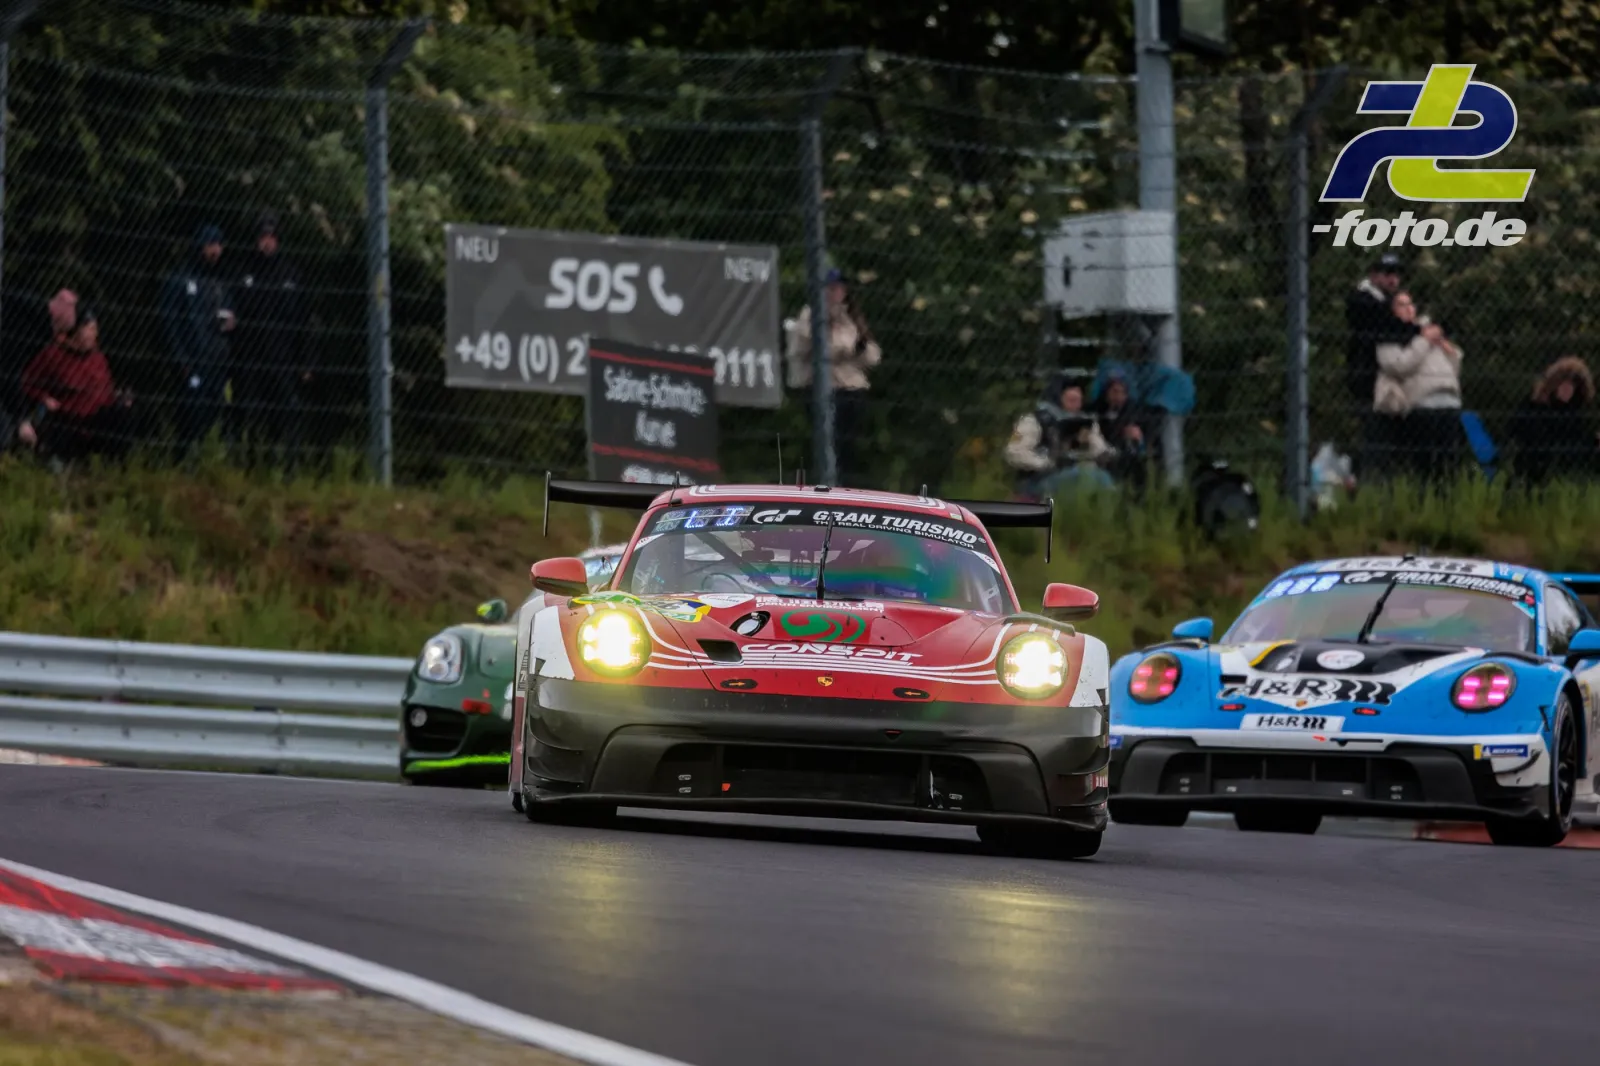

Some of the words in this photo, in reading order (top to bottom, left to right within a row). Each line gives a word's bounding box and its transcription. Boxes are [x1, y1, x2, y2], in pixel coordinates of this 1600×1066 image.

[455, 235, 499, 262] NEU
[724, 257, 771, 283] NEW
[545, 257, 641, 314] SOS
[455, 330, 512, 371] +49
[518, 333, 560, 384] (0)
[812, 510, 877, 524] GRAN
[868, 524, 912, 534] DRIVING
[914, 530, 974, 549] SIMULATOR
[741, 643, 923, 662] CONSPIT
